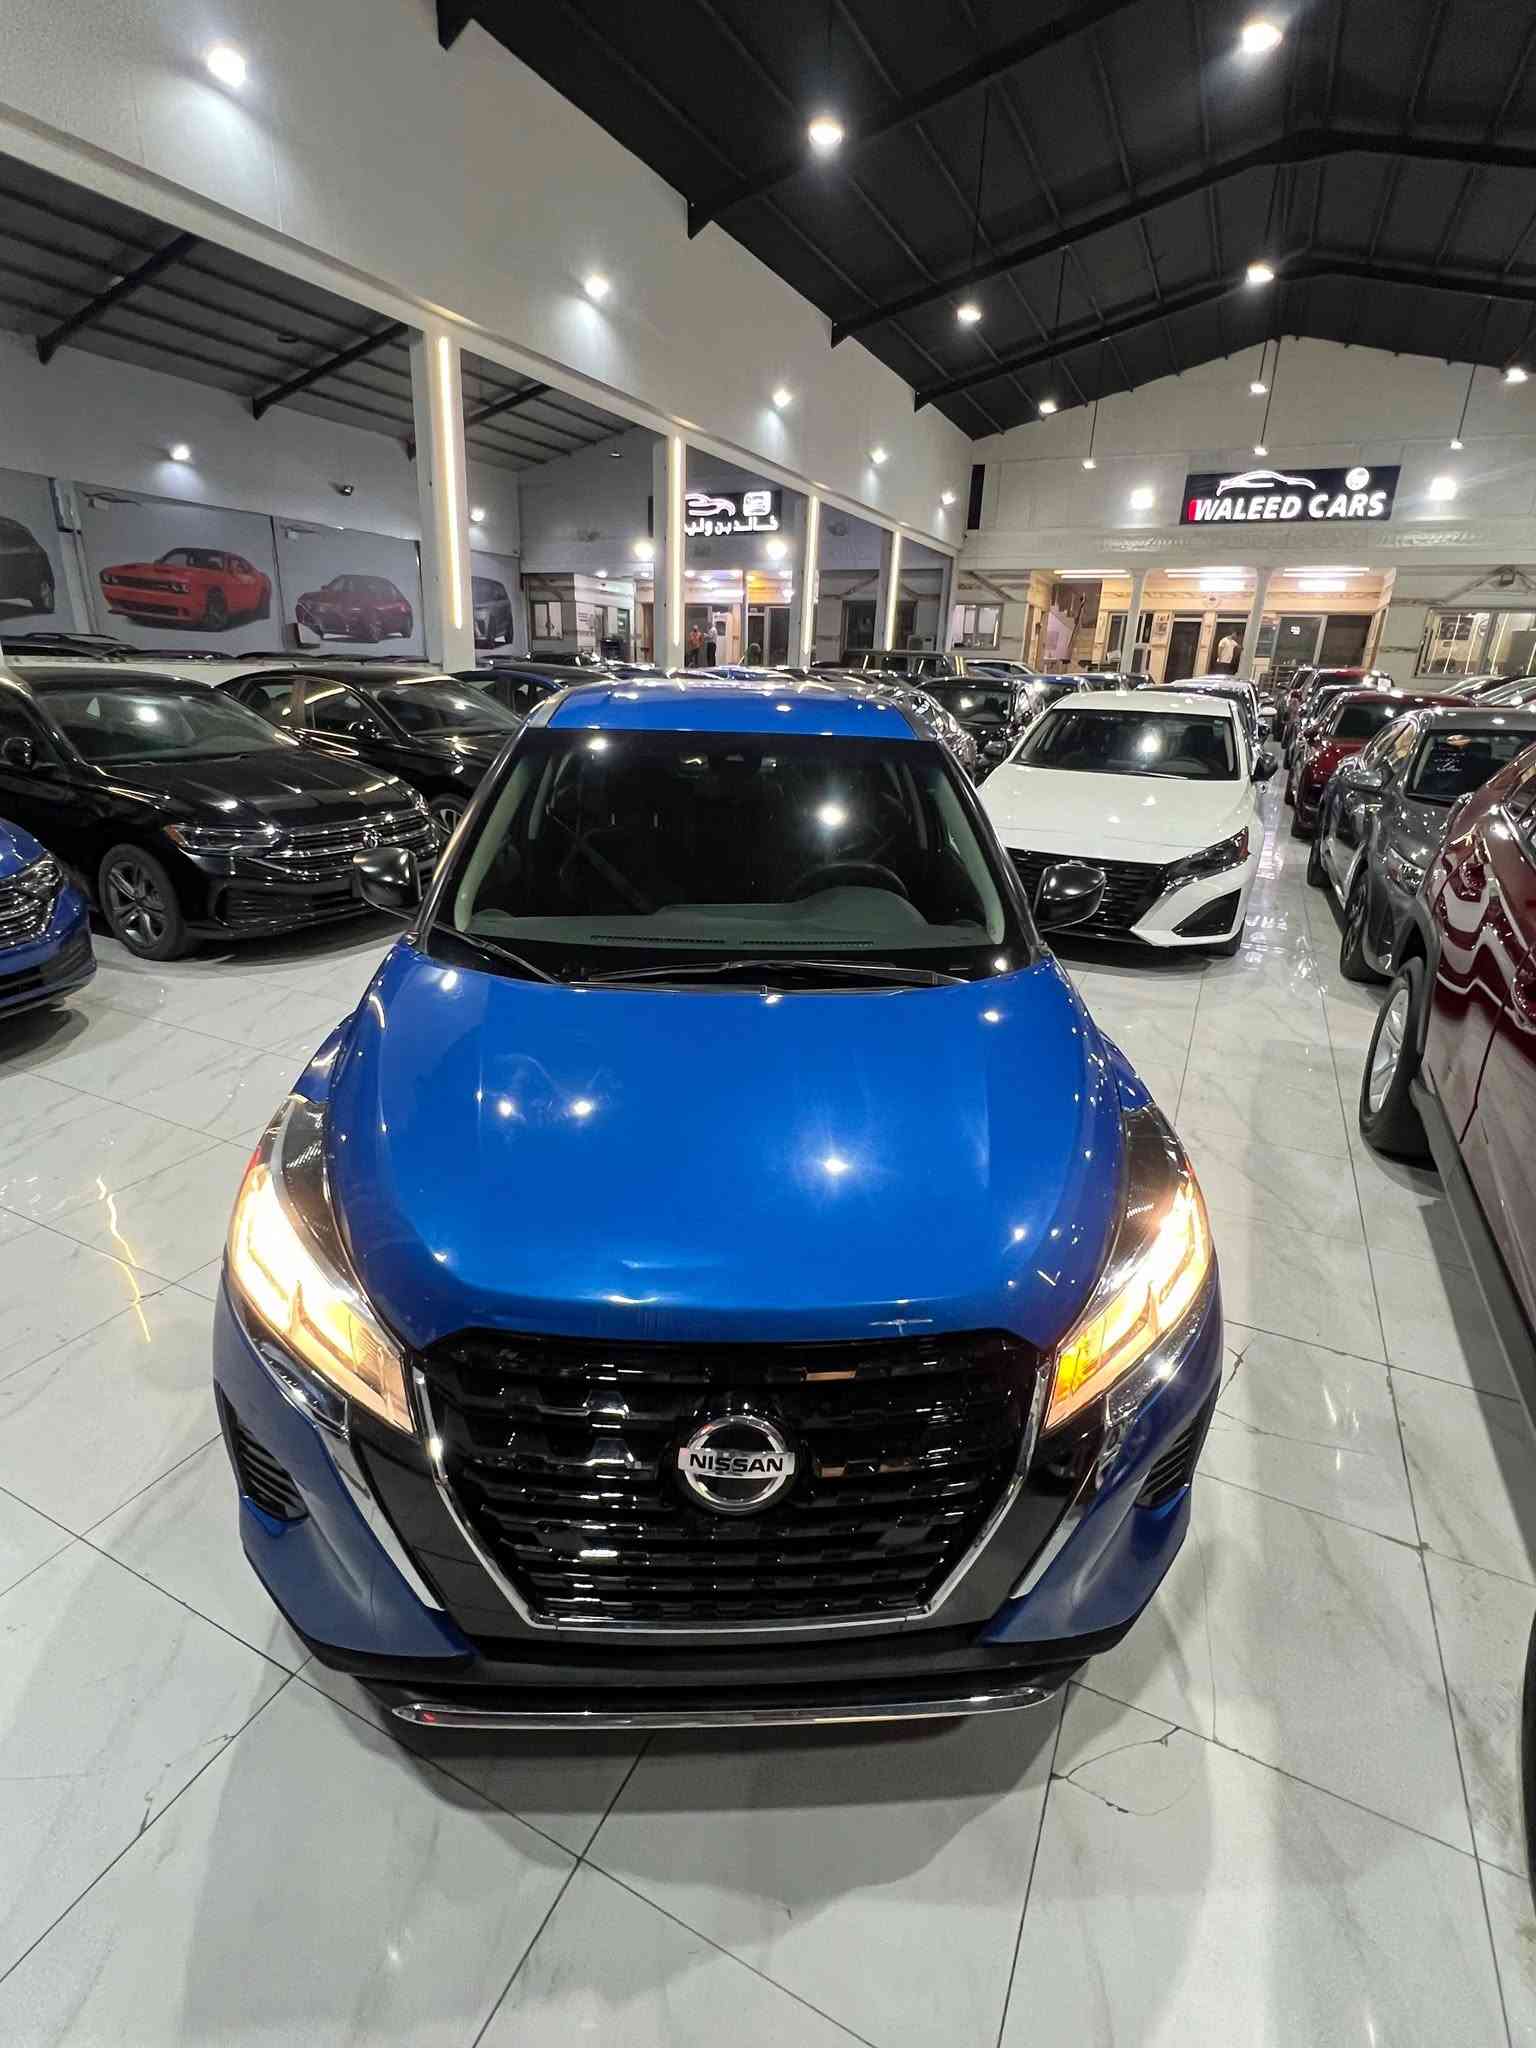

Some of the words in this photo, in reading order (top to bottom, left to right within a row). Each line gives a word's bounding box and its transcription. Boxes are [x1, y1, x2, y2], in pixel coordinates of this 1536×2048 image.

[1194, 495, 1302, 521] WALEED
[1308, 491, 1386, 519] CARS
[714, 520, 732, 536] بن
[733, 514, 779, 532] خالد
[689, 1453, 784, 1473] NISSAN
